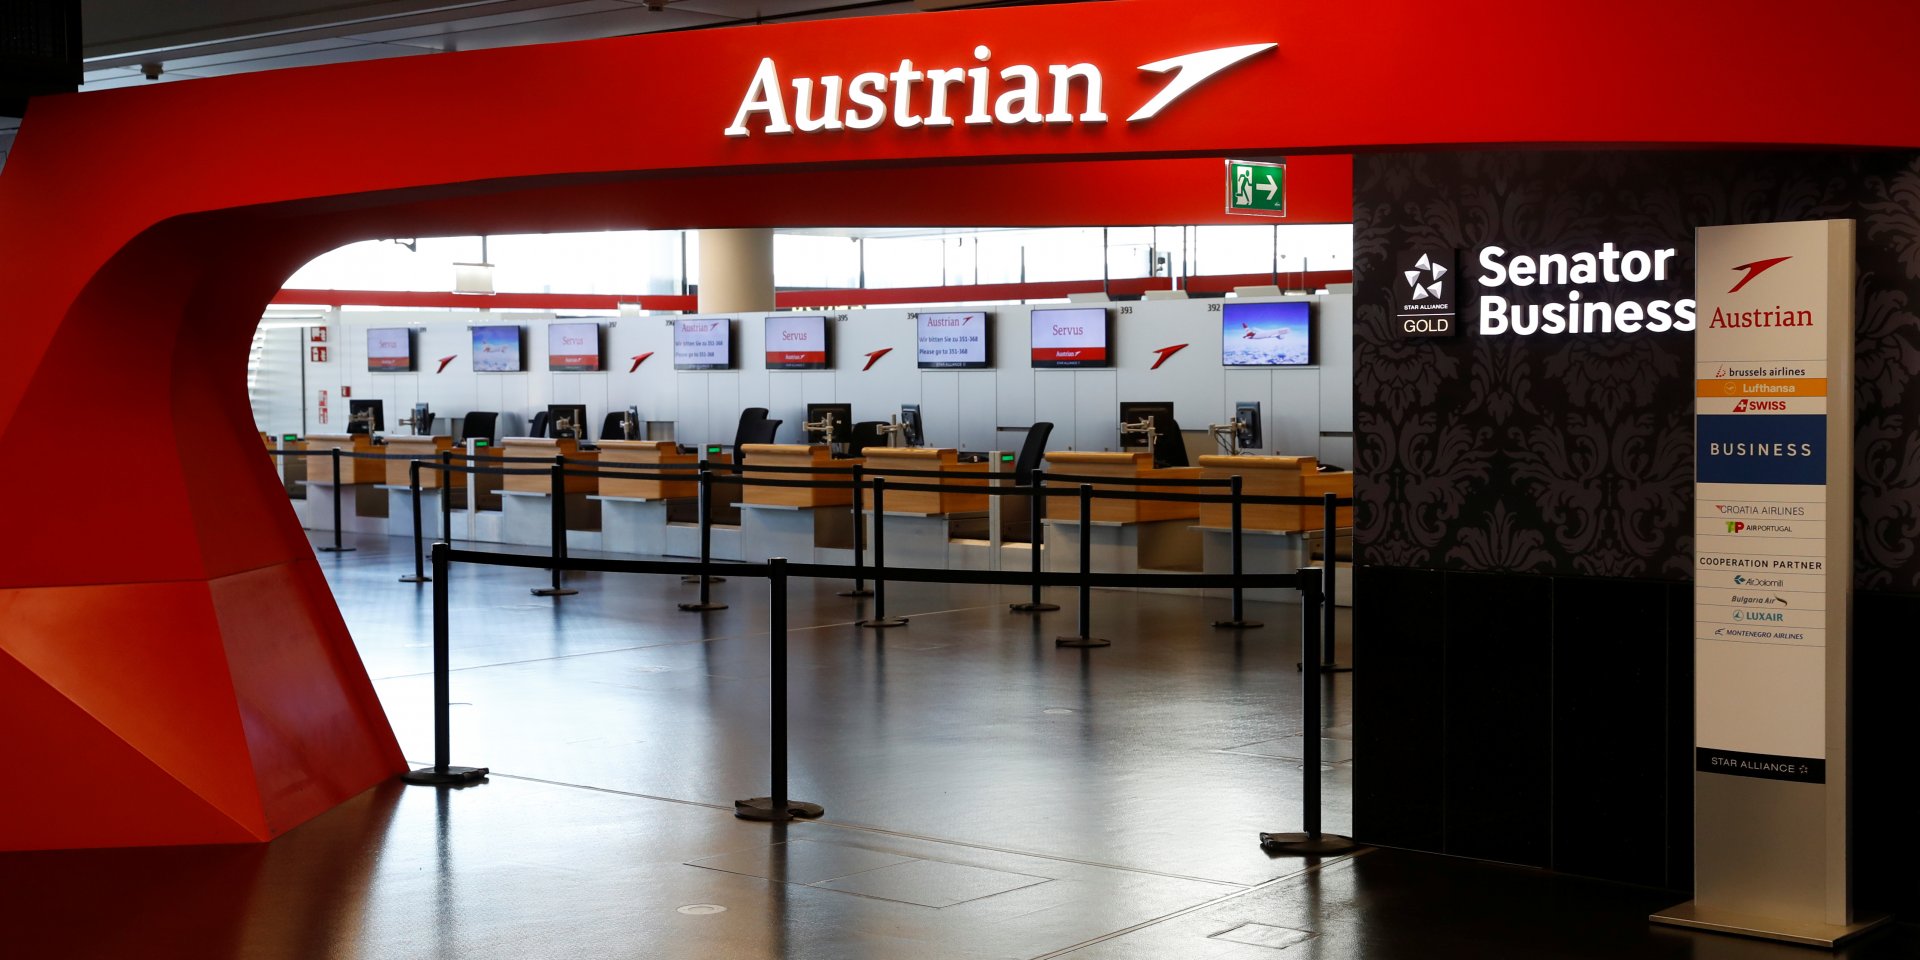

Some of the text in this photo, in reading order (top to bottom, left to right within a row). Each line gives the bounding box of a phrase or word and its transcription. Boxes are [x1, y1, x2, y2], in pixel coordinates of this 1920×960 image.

[724, 45, 1108, 137] Austrian
[1478, 242, 1676, 287] Senator
[1120, 306, 1133, 314] 393
[1208, 304, 1221, 312] 392
[1479, 290, 1696, 335] Business
[927, 316, 960, 327] Austrian
[1709, 305, 1814, 329] Austrian
[1052, 324, 1084, 336] Servus
[1403, 319, 1449, 333] GOLD
[782, 331, 807, 341] Servus
[1729, 367, 1806, 376] brussels airlines
[1743, 383, 1795, 393] Lufthansa
[1750, 401, 1786, 410] SWISS
[1710, 443, 1812, 457] BUSINESS
[1720, 505, 1805, 516] CROATIA AIRLINES
[1699, 557, 1822, 570] COOPERATION PARTNER
[1731, 595, 1763, 605] Bulgaria
[1746, 612, 1784, 622] LUXAIR
[1726, 629, 1803, 640] MONTENEGRO AIRLINES
[1711, 756, 1795, 773] STAR ALLIANCE
